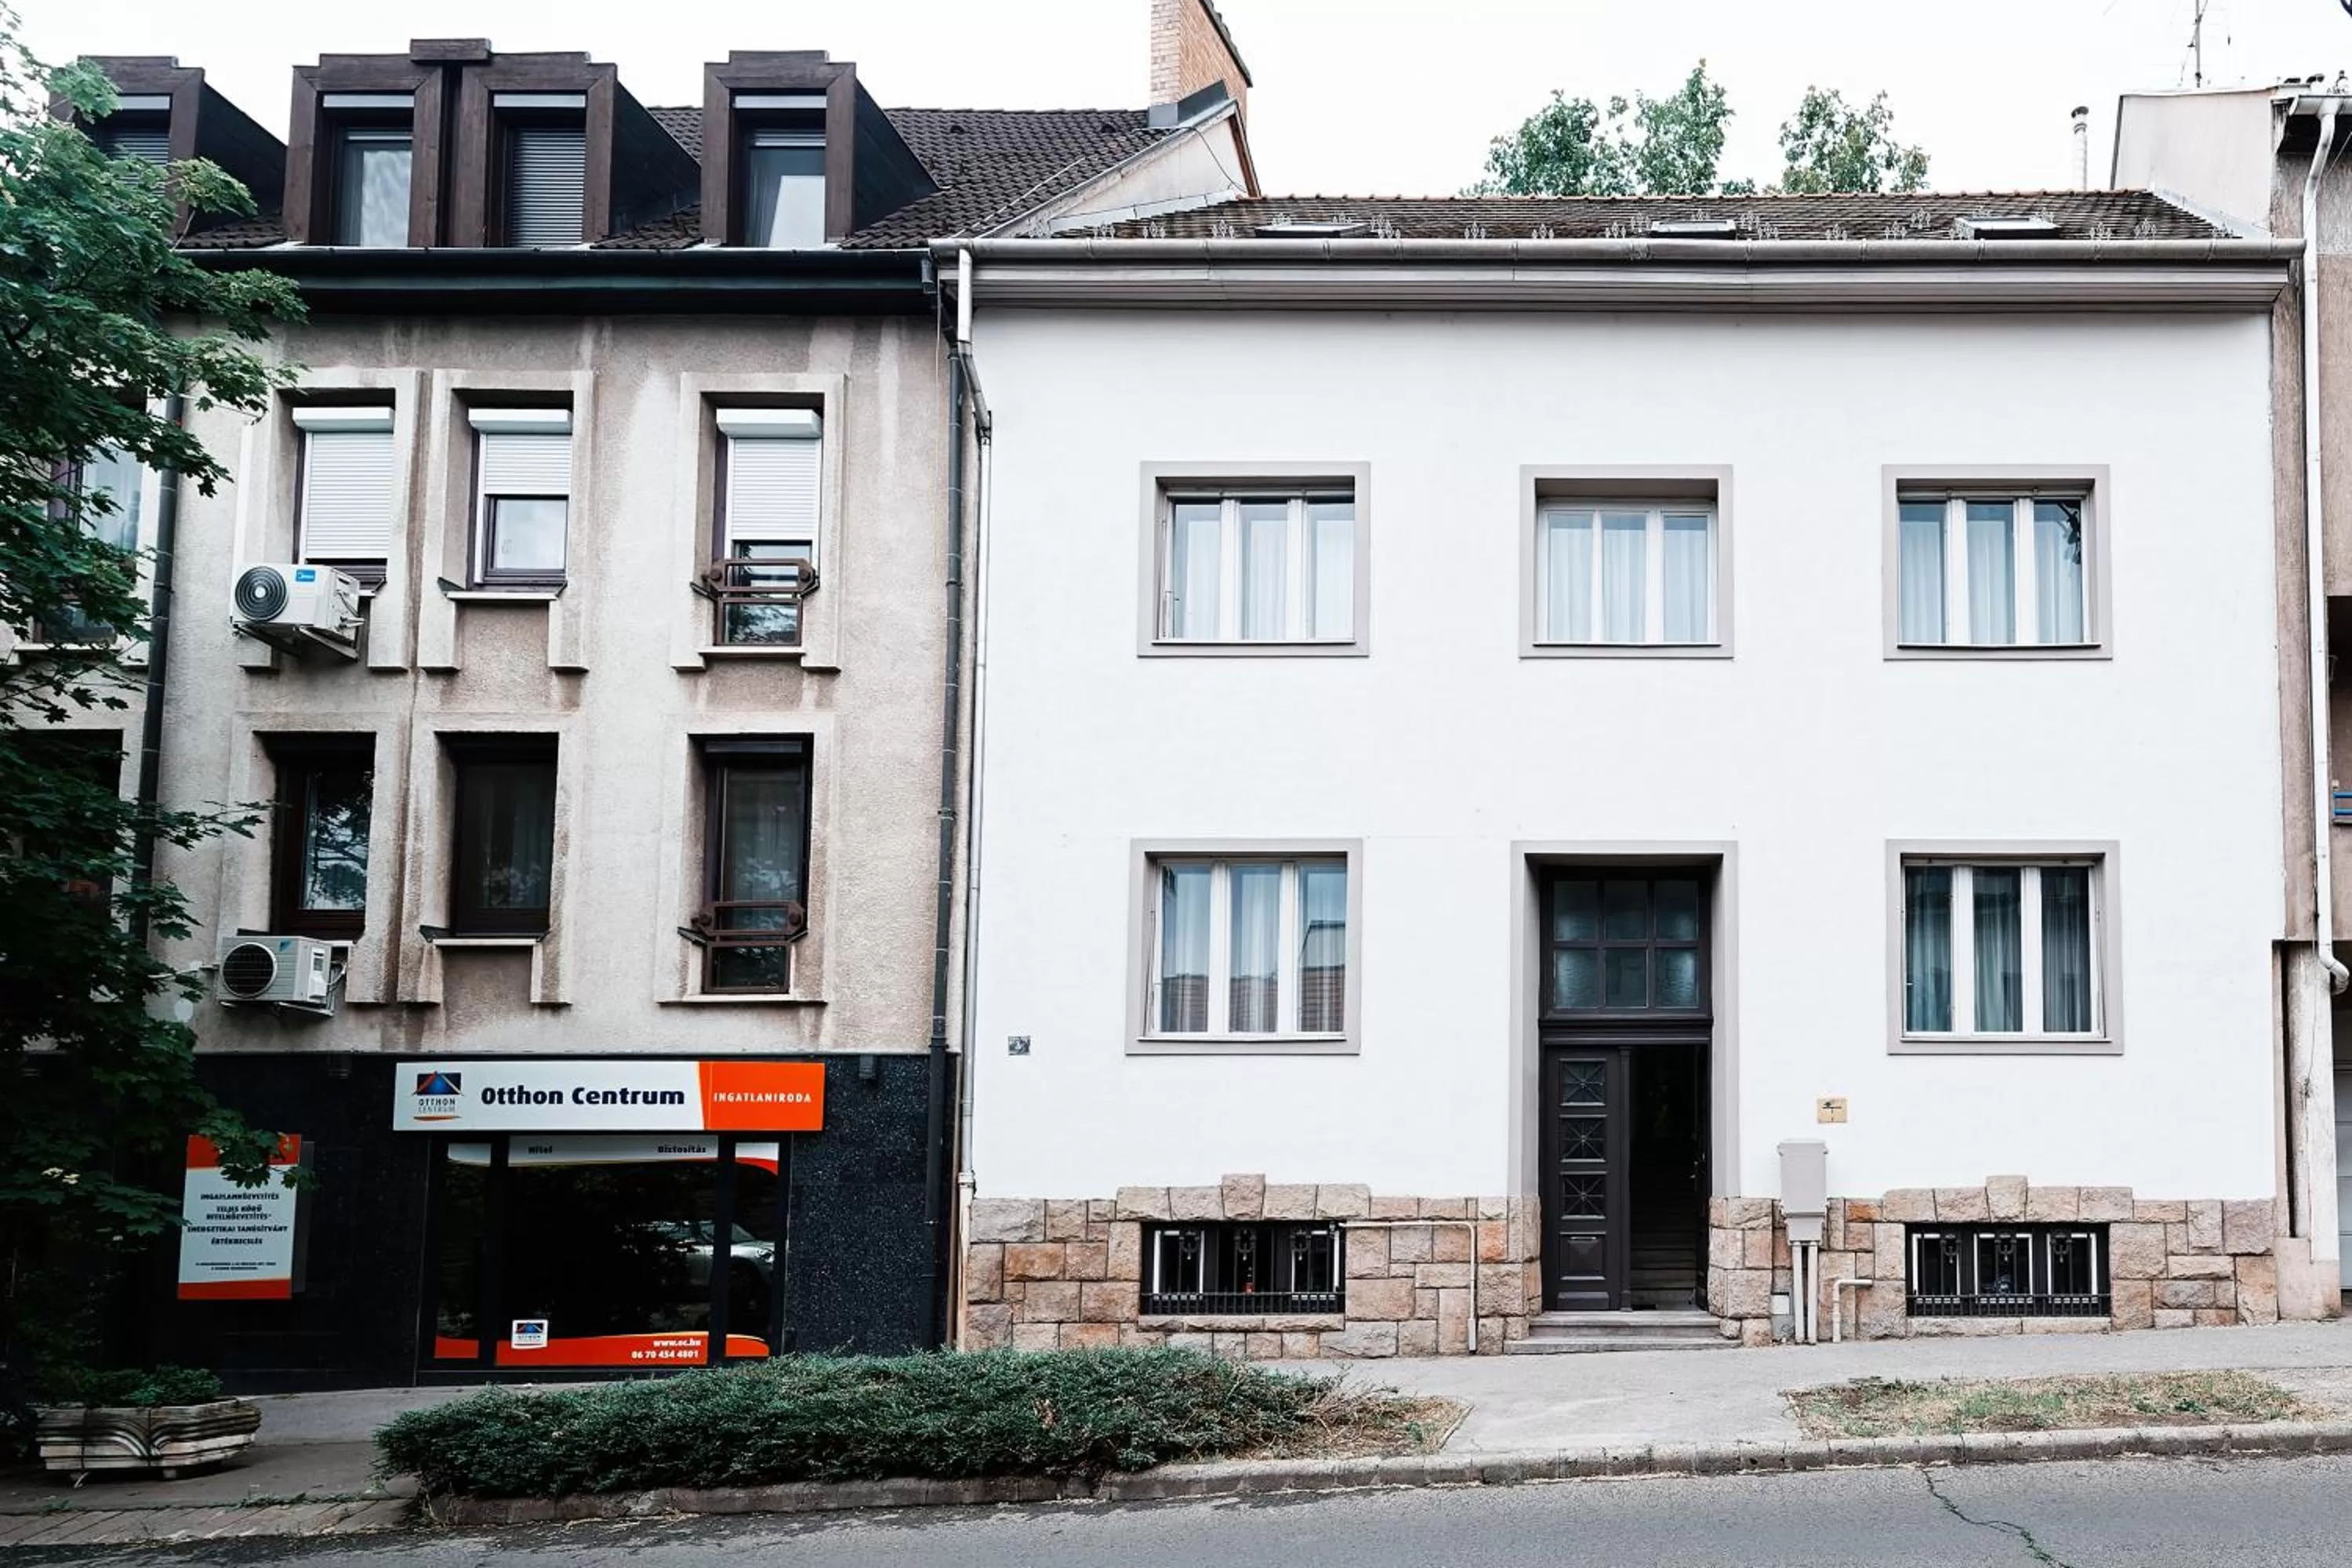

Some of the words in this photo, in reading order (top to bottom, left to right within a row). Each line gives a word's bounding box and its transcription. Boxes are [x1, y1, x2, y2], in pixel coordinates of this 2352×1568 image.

[481, 1086, 564, 1105] Otthon
[572, 1086, 685, 1105] Centrum
[713, 1092, 812, 1104] INGATLANIRODA
[528, 1145, 553, 1154] Hitel
[657, 1144, 706, 1153] Biztosítás
